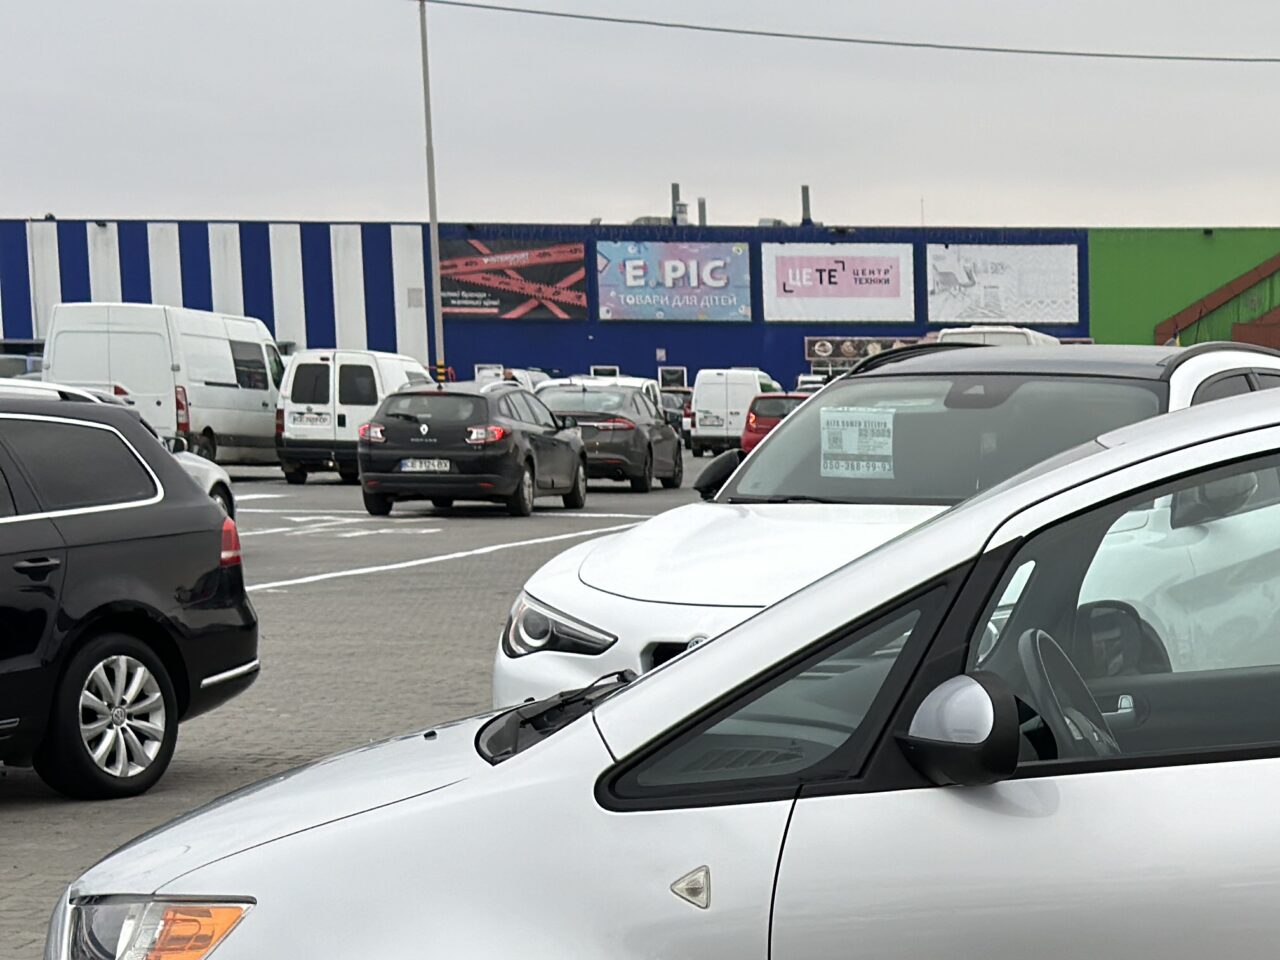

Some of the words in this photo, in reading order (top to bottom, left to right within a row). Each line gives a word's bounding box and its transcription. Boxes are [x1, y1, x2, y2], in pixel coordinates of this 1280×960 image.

[852, 268, 890, 277] ЦЕНТР
[618, 294, 669, 306] ТОВАРИ
[671, 295, 698, 308] ДЛЯ
[700, 291, 737, 307] ДІТЕЙ
